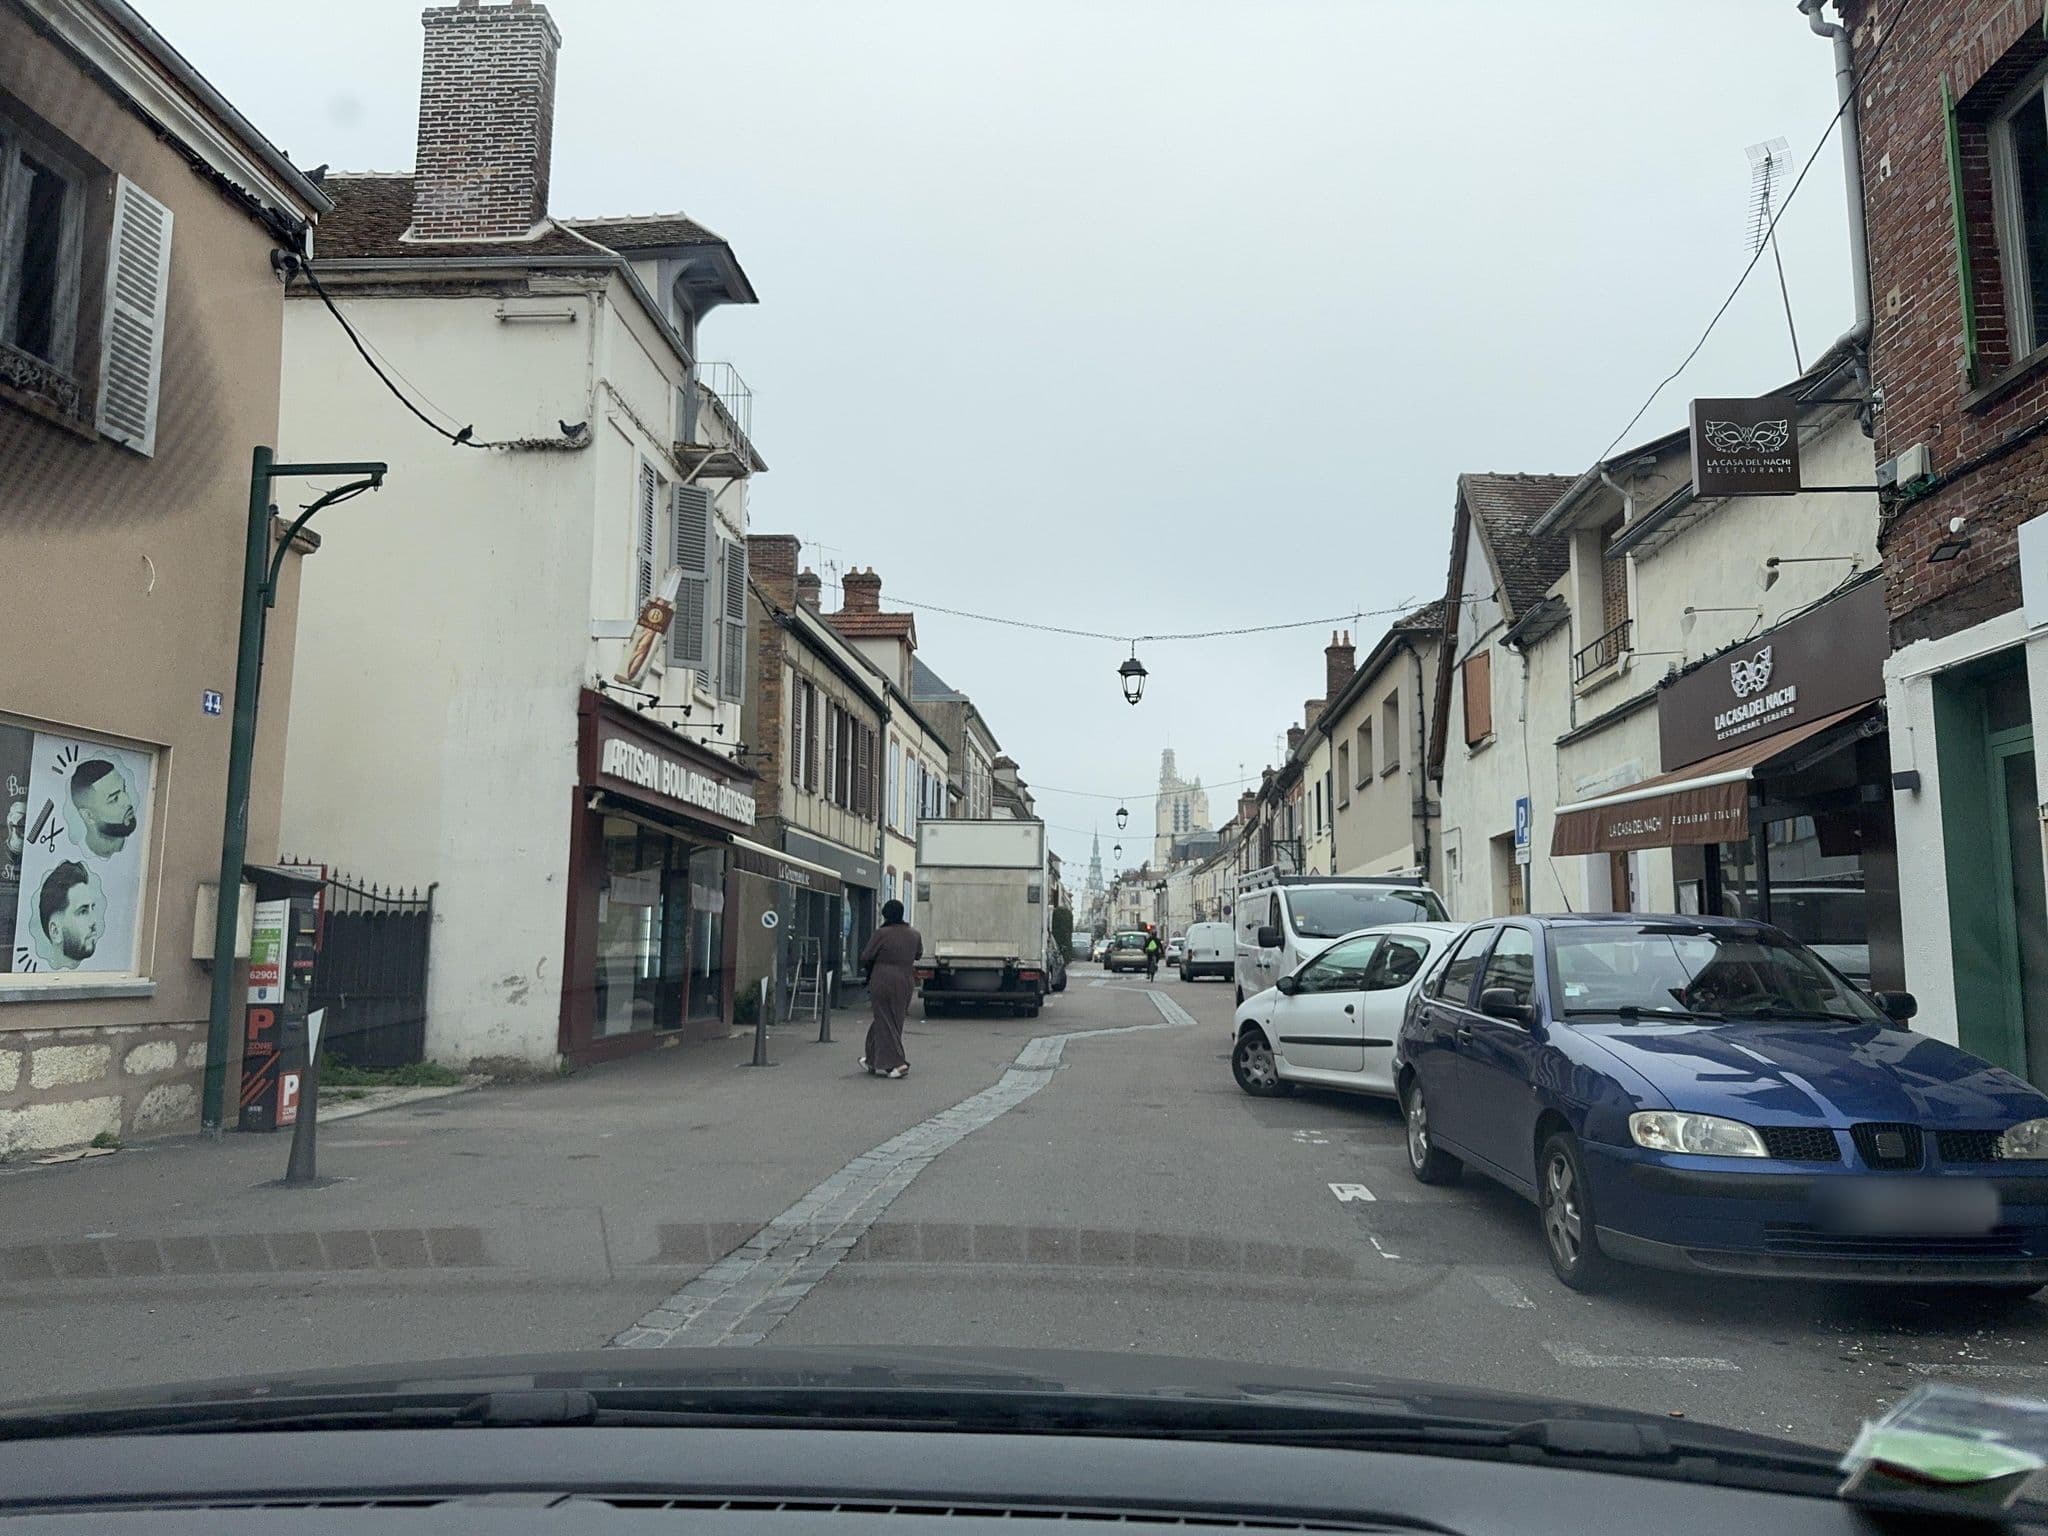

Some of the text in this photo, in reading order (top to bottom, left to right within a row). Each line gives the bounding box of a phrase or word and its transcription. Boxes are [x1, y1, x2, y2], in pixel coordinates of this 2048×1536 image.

[204, 691, 221, 713] 44
[1714, 685, 1797, 731] LA CASA DEL NACHI
[601, 738, 660, 791] ARTISAN
[663, 759, 718, 813] BOULANGER
[1518, 806, 1526, 837] P
[1672, 811, 1710, 825] ESTAURANT
[249, 970, 278, 979] 62901
[248, 1008, 275, 1041] P
[283, 1074, 300, 1107] P
